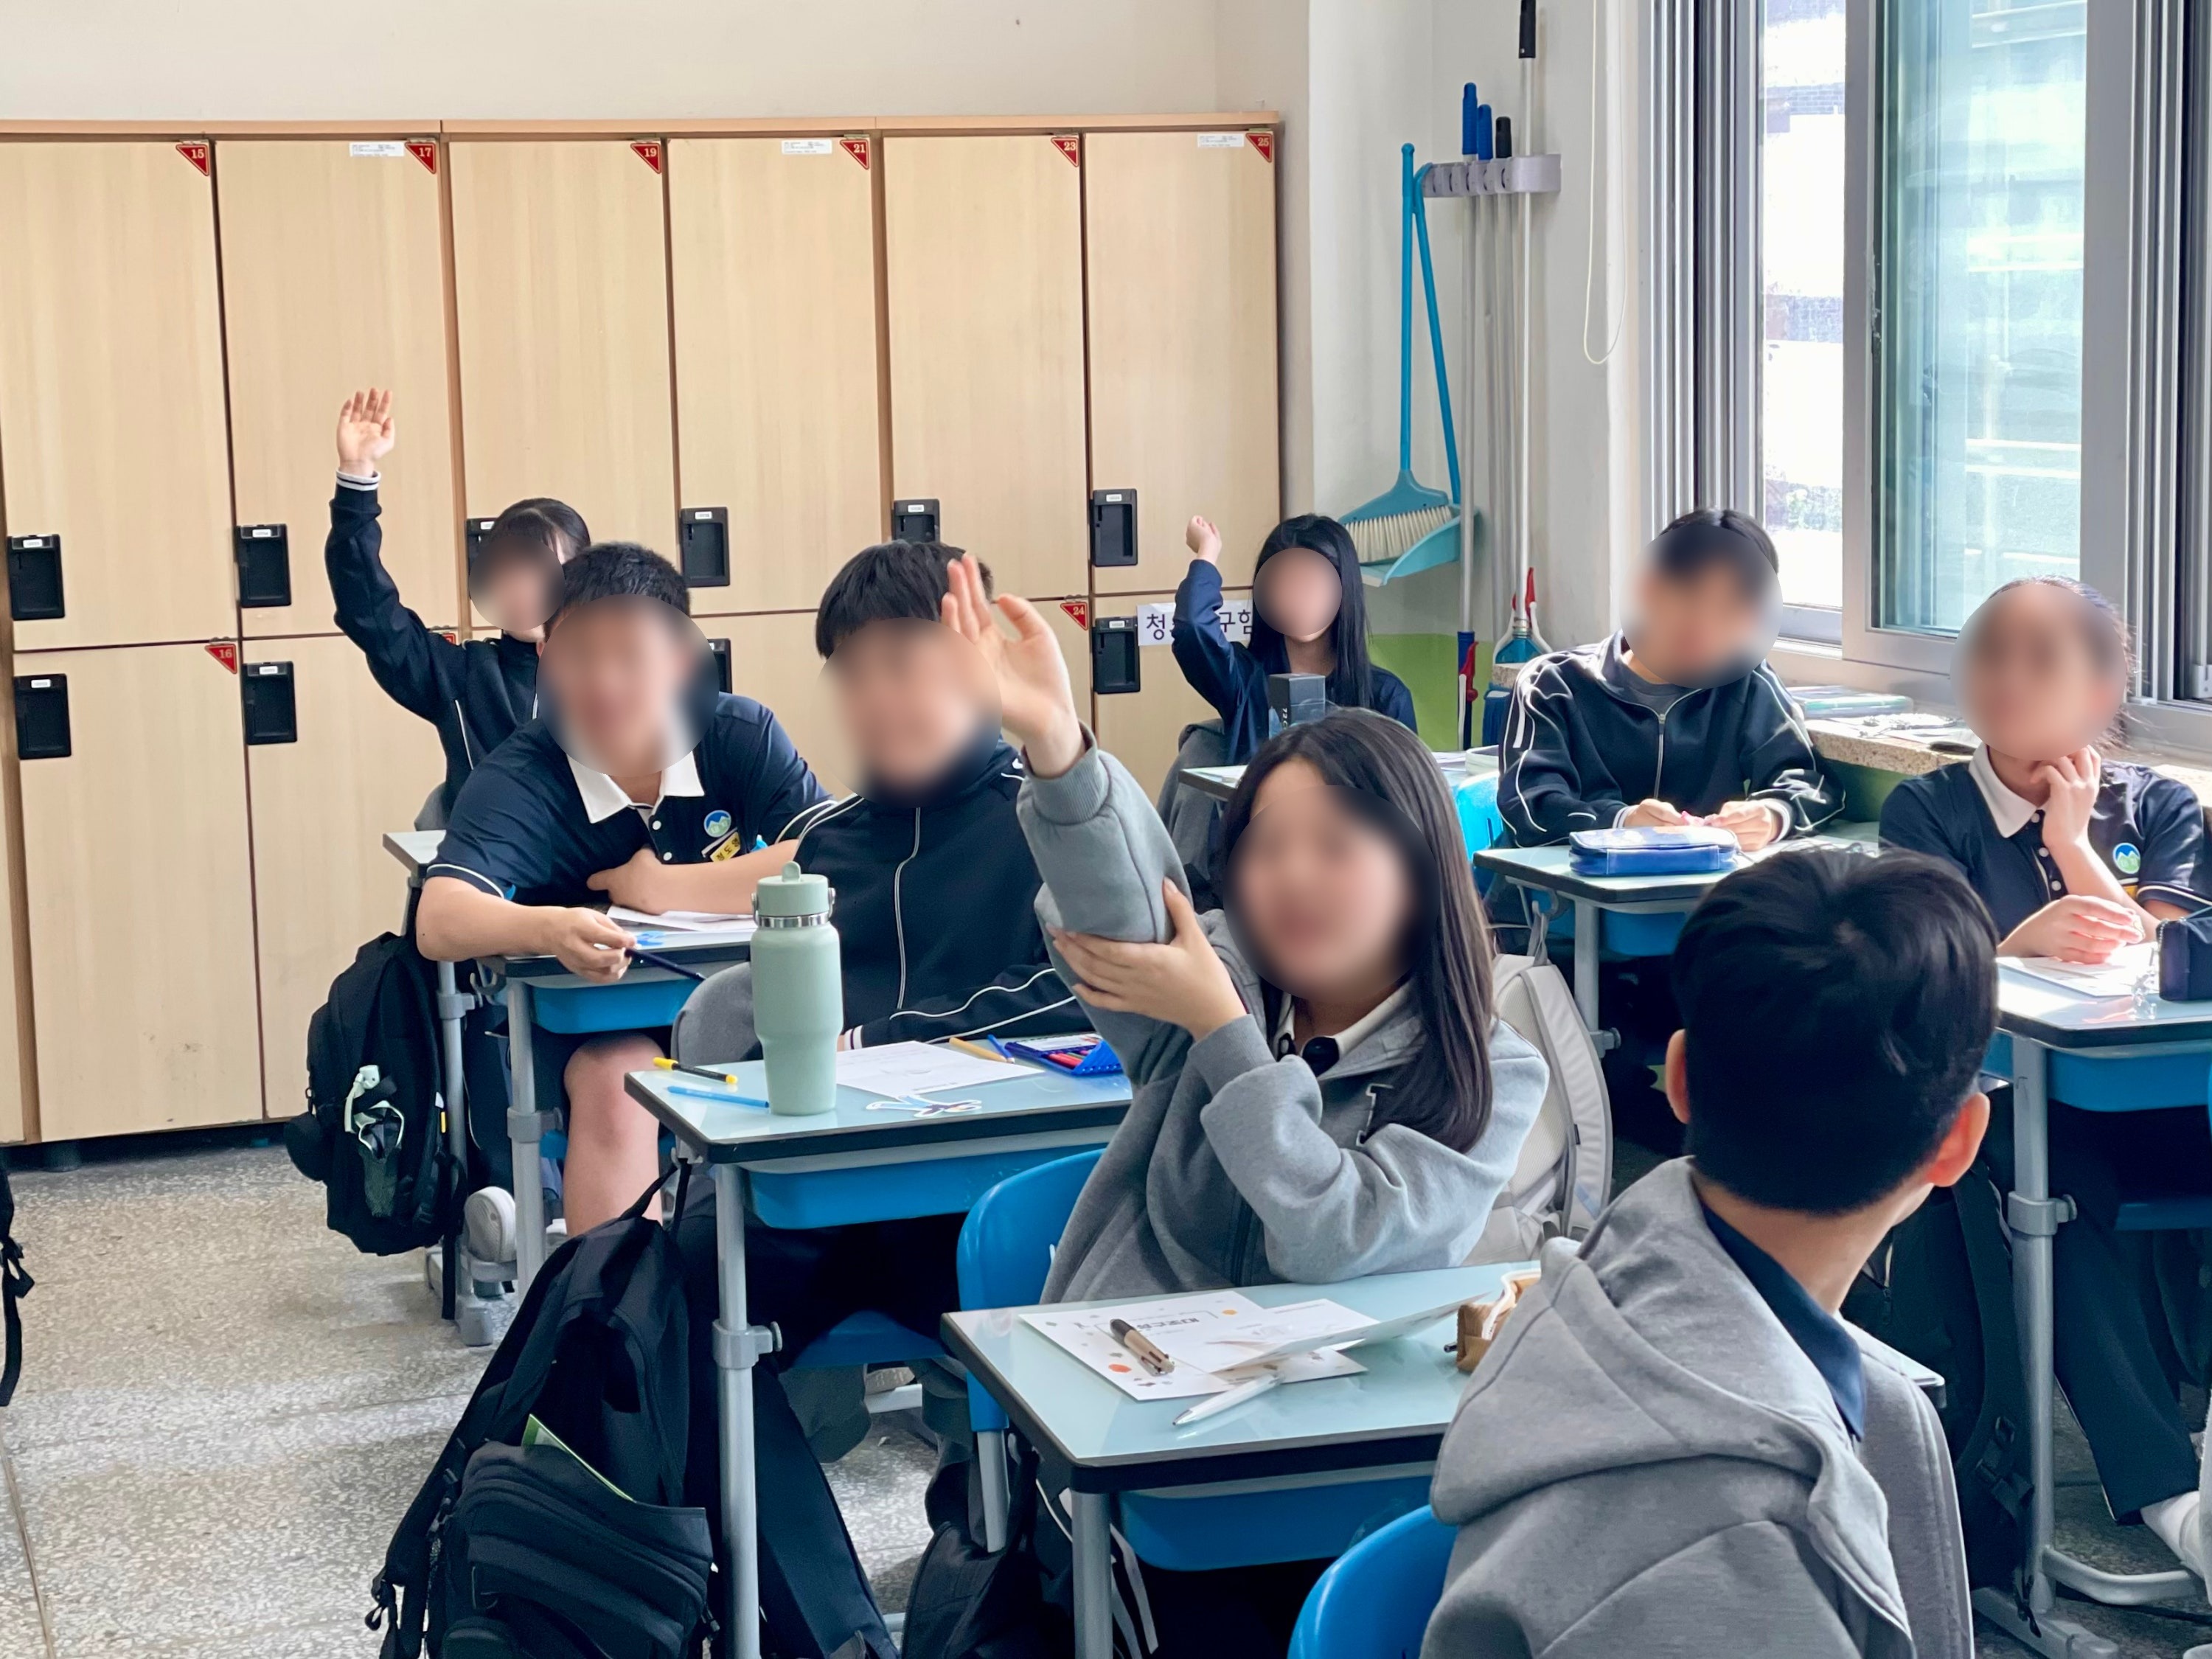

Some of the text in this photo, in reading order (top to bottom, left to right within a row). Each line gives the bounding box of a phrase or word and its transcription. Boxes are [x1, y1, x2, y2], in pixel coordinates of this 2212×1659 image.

[1063, 142, 1076, 150] 23
[1258, 137, 1269, 147] 25
[419, 147, 432, 157] 17
[644, 147, 656, 157] 19
[853, 143, 866, 153] 21
[191, 149, 204, 159] 15
[1073, 606, 1085, 615] 24
[219, 649, 232, 658] 16
